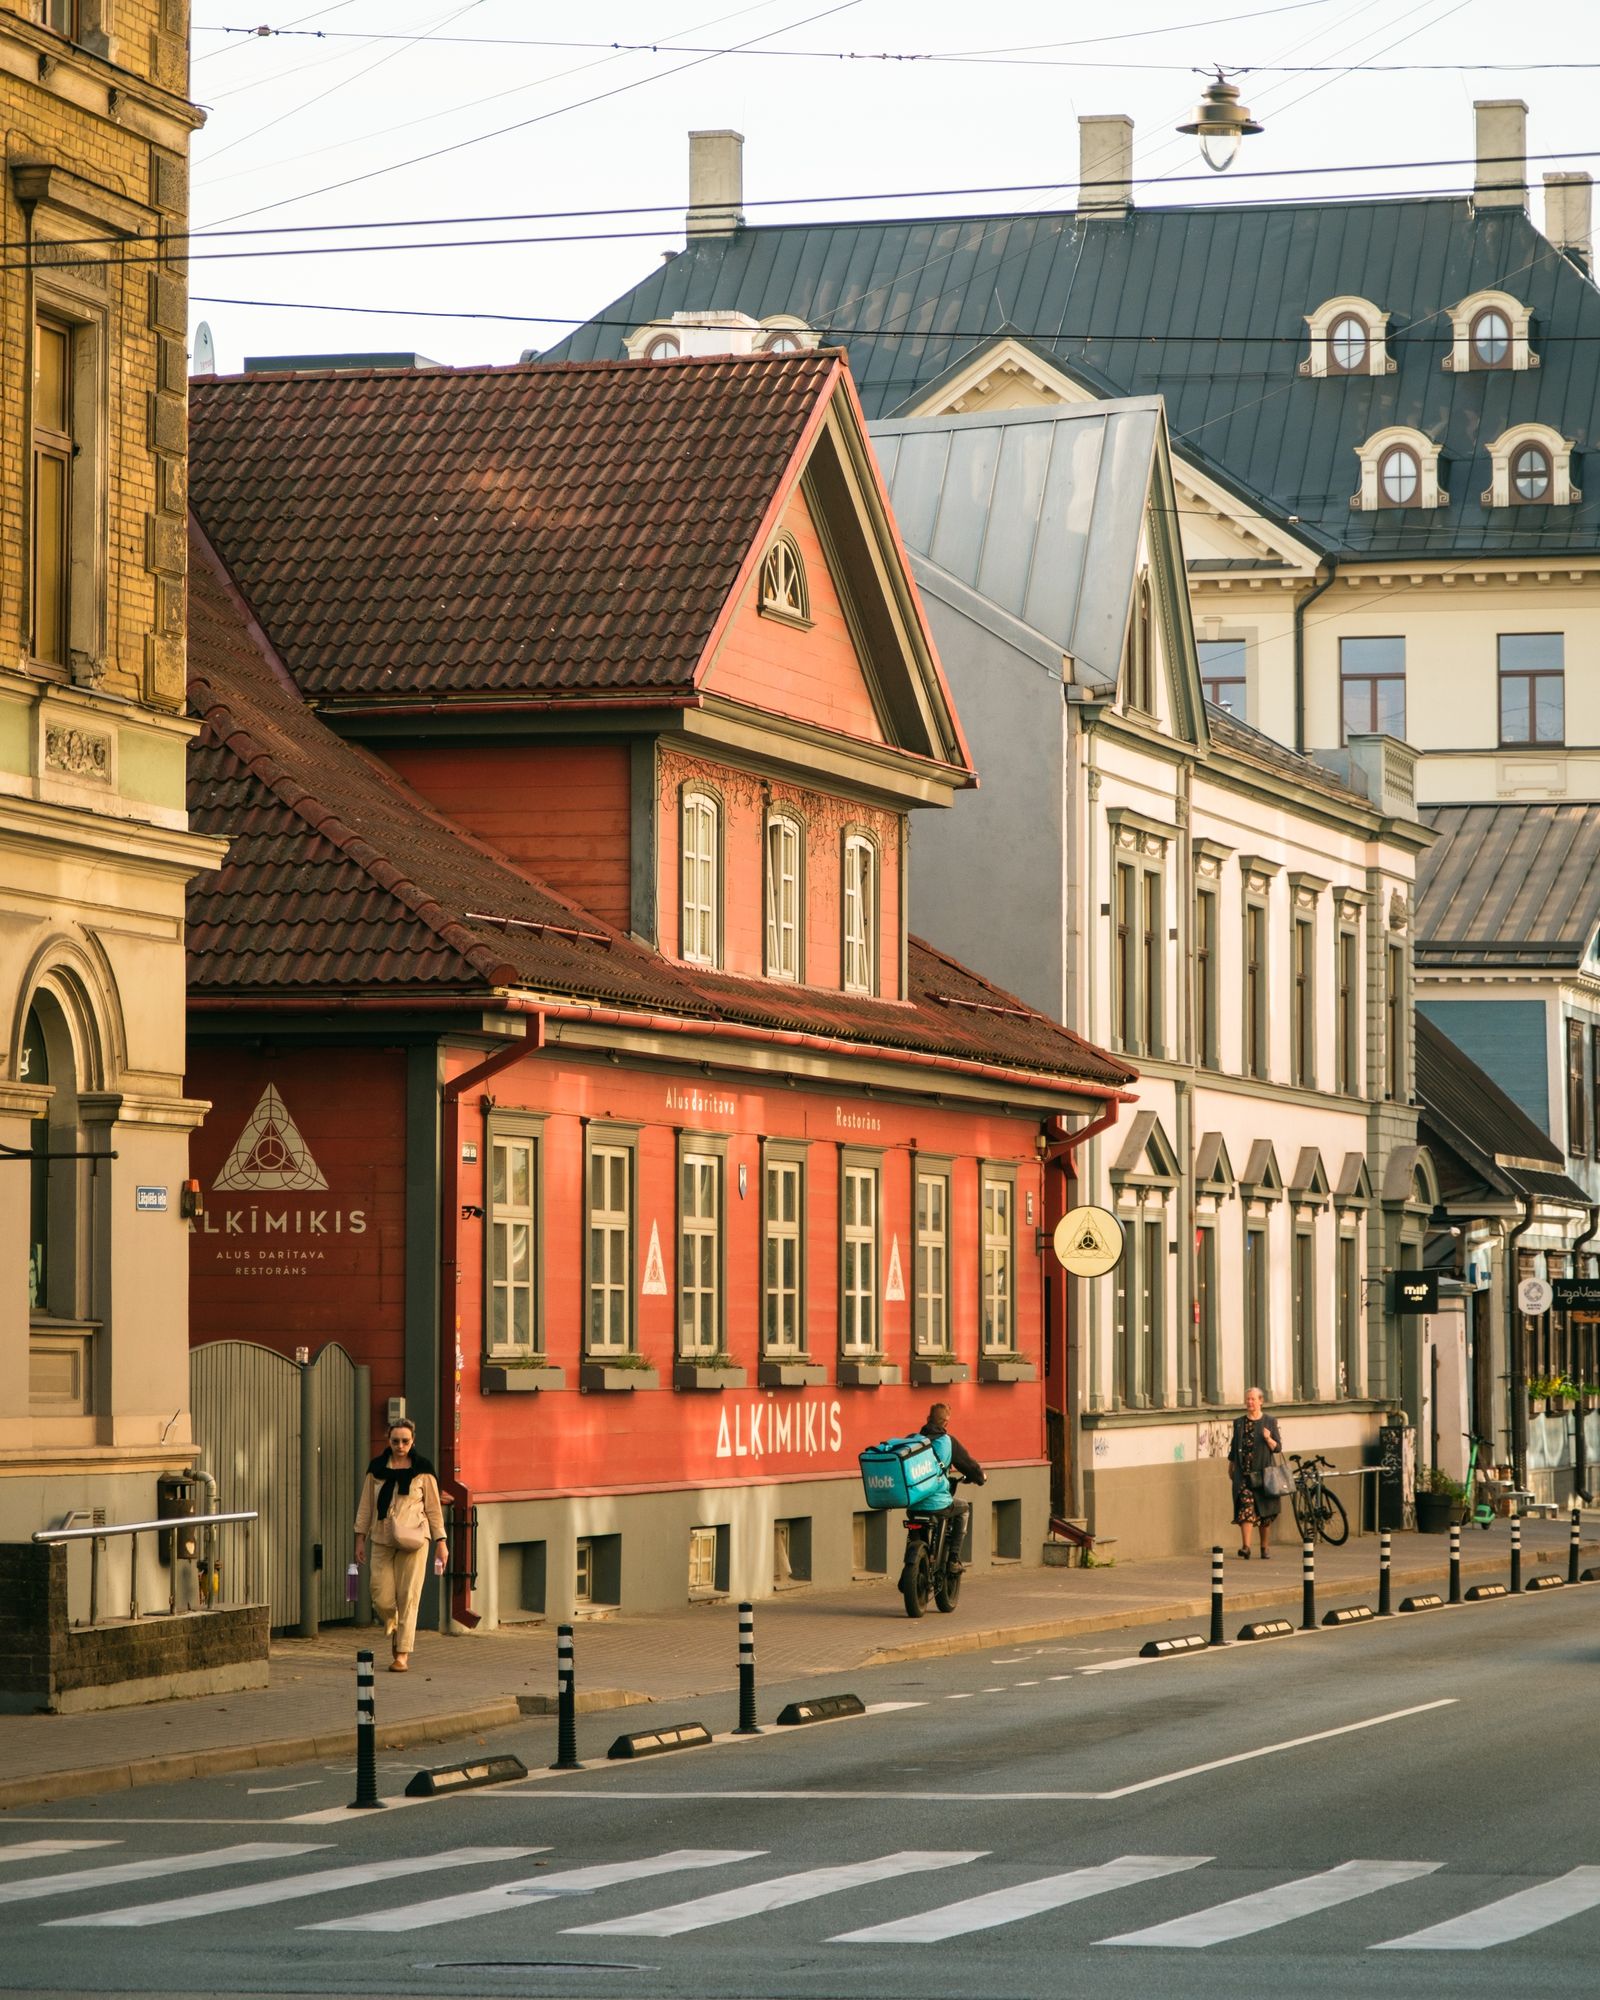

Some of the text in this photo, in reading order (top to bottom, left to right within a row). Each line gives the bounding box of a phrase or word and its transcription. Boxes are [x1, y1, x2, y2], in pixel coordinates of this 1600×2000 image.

[666, 1087, 689, 1110] Alus
[216, 1250, 325, 1259] ALUS DARĪTAVA
[235, 1265, 307, 1275] RESTORĀNS
[911, 1461, 932, 1479] Wolt
[868, 1475, 895, 1488] Wolt
